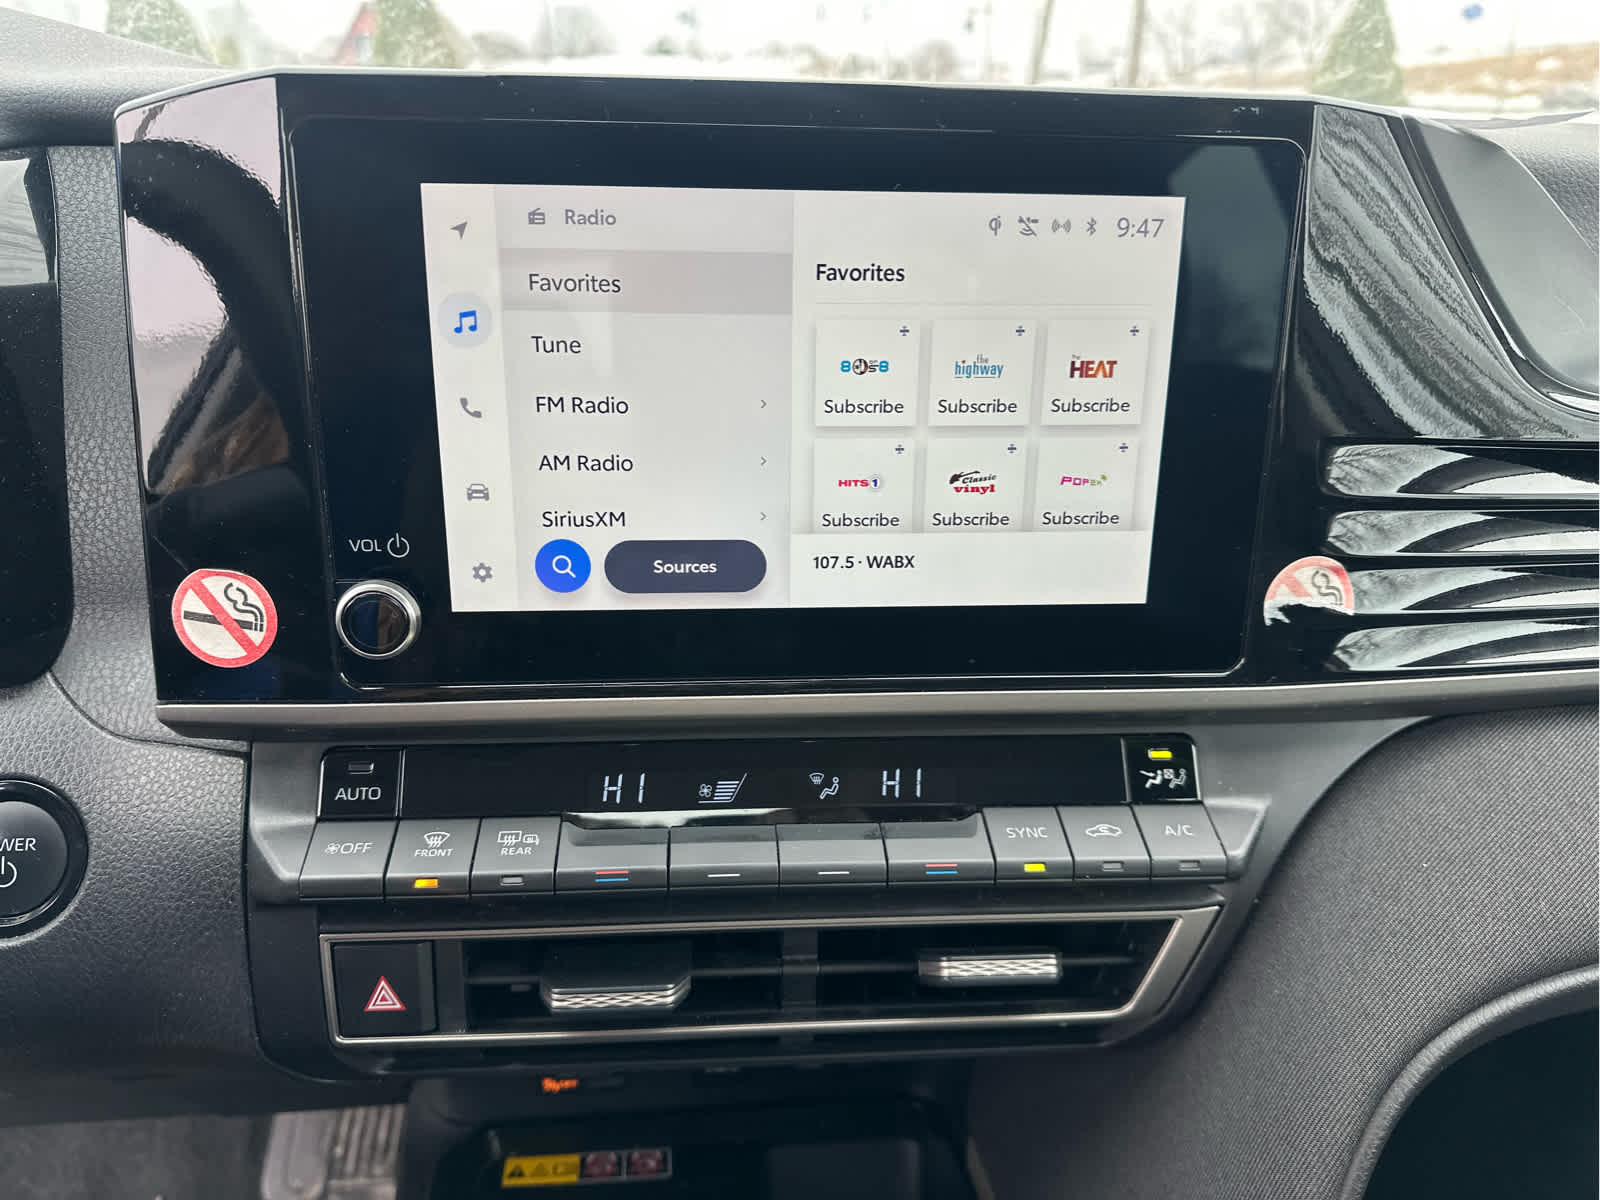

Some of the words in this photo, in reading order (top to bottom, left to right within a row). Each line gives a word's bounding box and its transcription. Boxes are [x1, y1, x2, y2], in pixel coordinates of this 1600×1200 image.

[564, 208, 617, 227] Radio
[1116, 217, 1165, 238] 9:47
[815, 264, 905, 283] Favorites
[528, 273, 621, 293] Favorites
[531, 336, 581, 354] Tune
[954, 359, 1004, 379] highway
[1069, 360, 1118, 379] HEAT
[535, 396, 565, 413] FM
[572, 396, 629, 415] Radio
[824, 399, 905, 415] Subscribe
[937, 399, 1018, 415] Subscribe
[1050, 398, 1131, 414] Subscribe
[538, 455, 570, 472] AM
[577, 454, 634, 473] Radio
[838, 479, 870, 487] HITS
[953, 483, 996, 495] vinyl
[541, 510, 627, 529] SiriusXM
[822, 512, 901, 528] Subscribe
[932, 511, 1010, 527] Subscribe
[1042, 510, 1121, 526] Subscribe
[348, 538, 382, 552] VOL
[653, 559, 718, 575] Sources
[812, 556, 855, 570] 107.5
[866, 555, 916, 570] WABX
[334, 785, 383, 802] AUTO
[1005, 825, 1049, 840] SYNC
[1164, 823, 1194, 837] A/C
[0, 837, 37, 852] WER
[340, 841, 373, 856] OFF
[499, 844, 534, 857] REAR
[413, 847, 455, 859] FRONT
